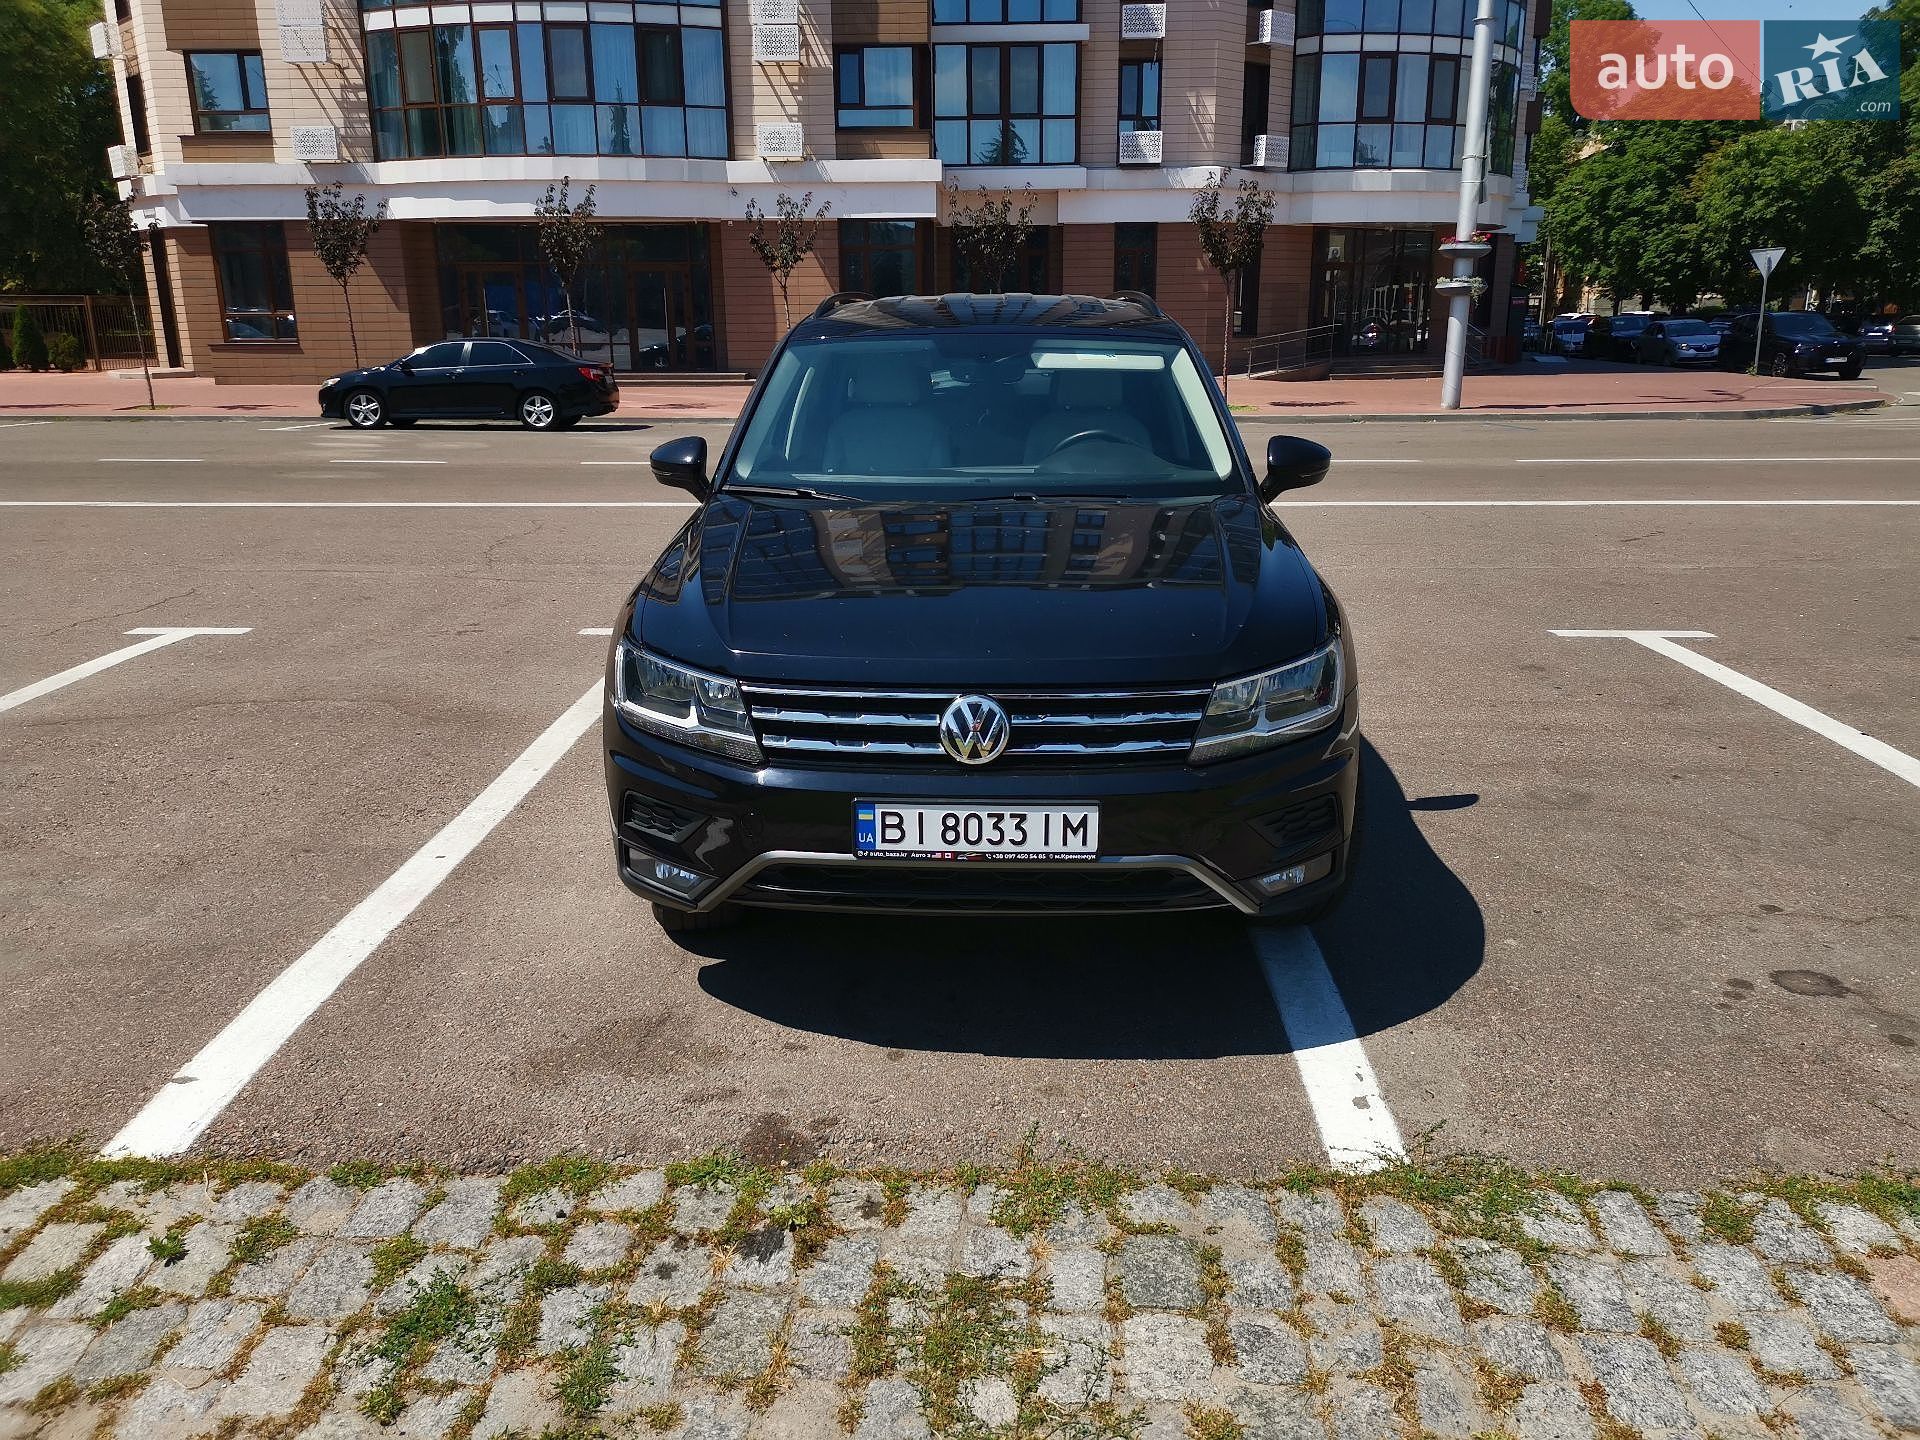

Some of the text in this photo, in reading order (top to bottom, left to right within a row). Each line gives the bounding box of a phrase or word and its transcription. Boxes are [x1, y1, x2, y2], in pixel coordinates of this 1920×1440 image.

[858, 832, 874, 843] UA
[880, 811, 1088, 847] BI 8033 IM
